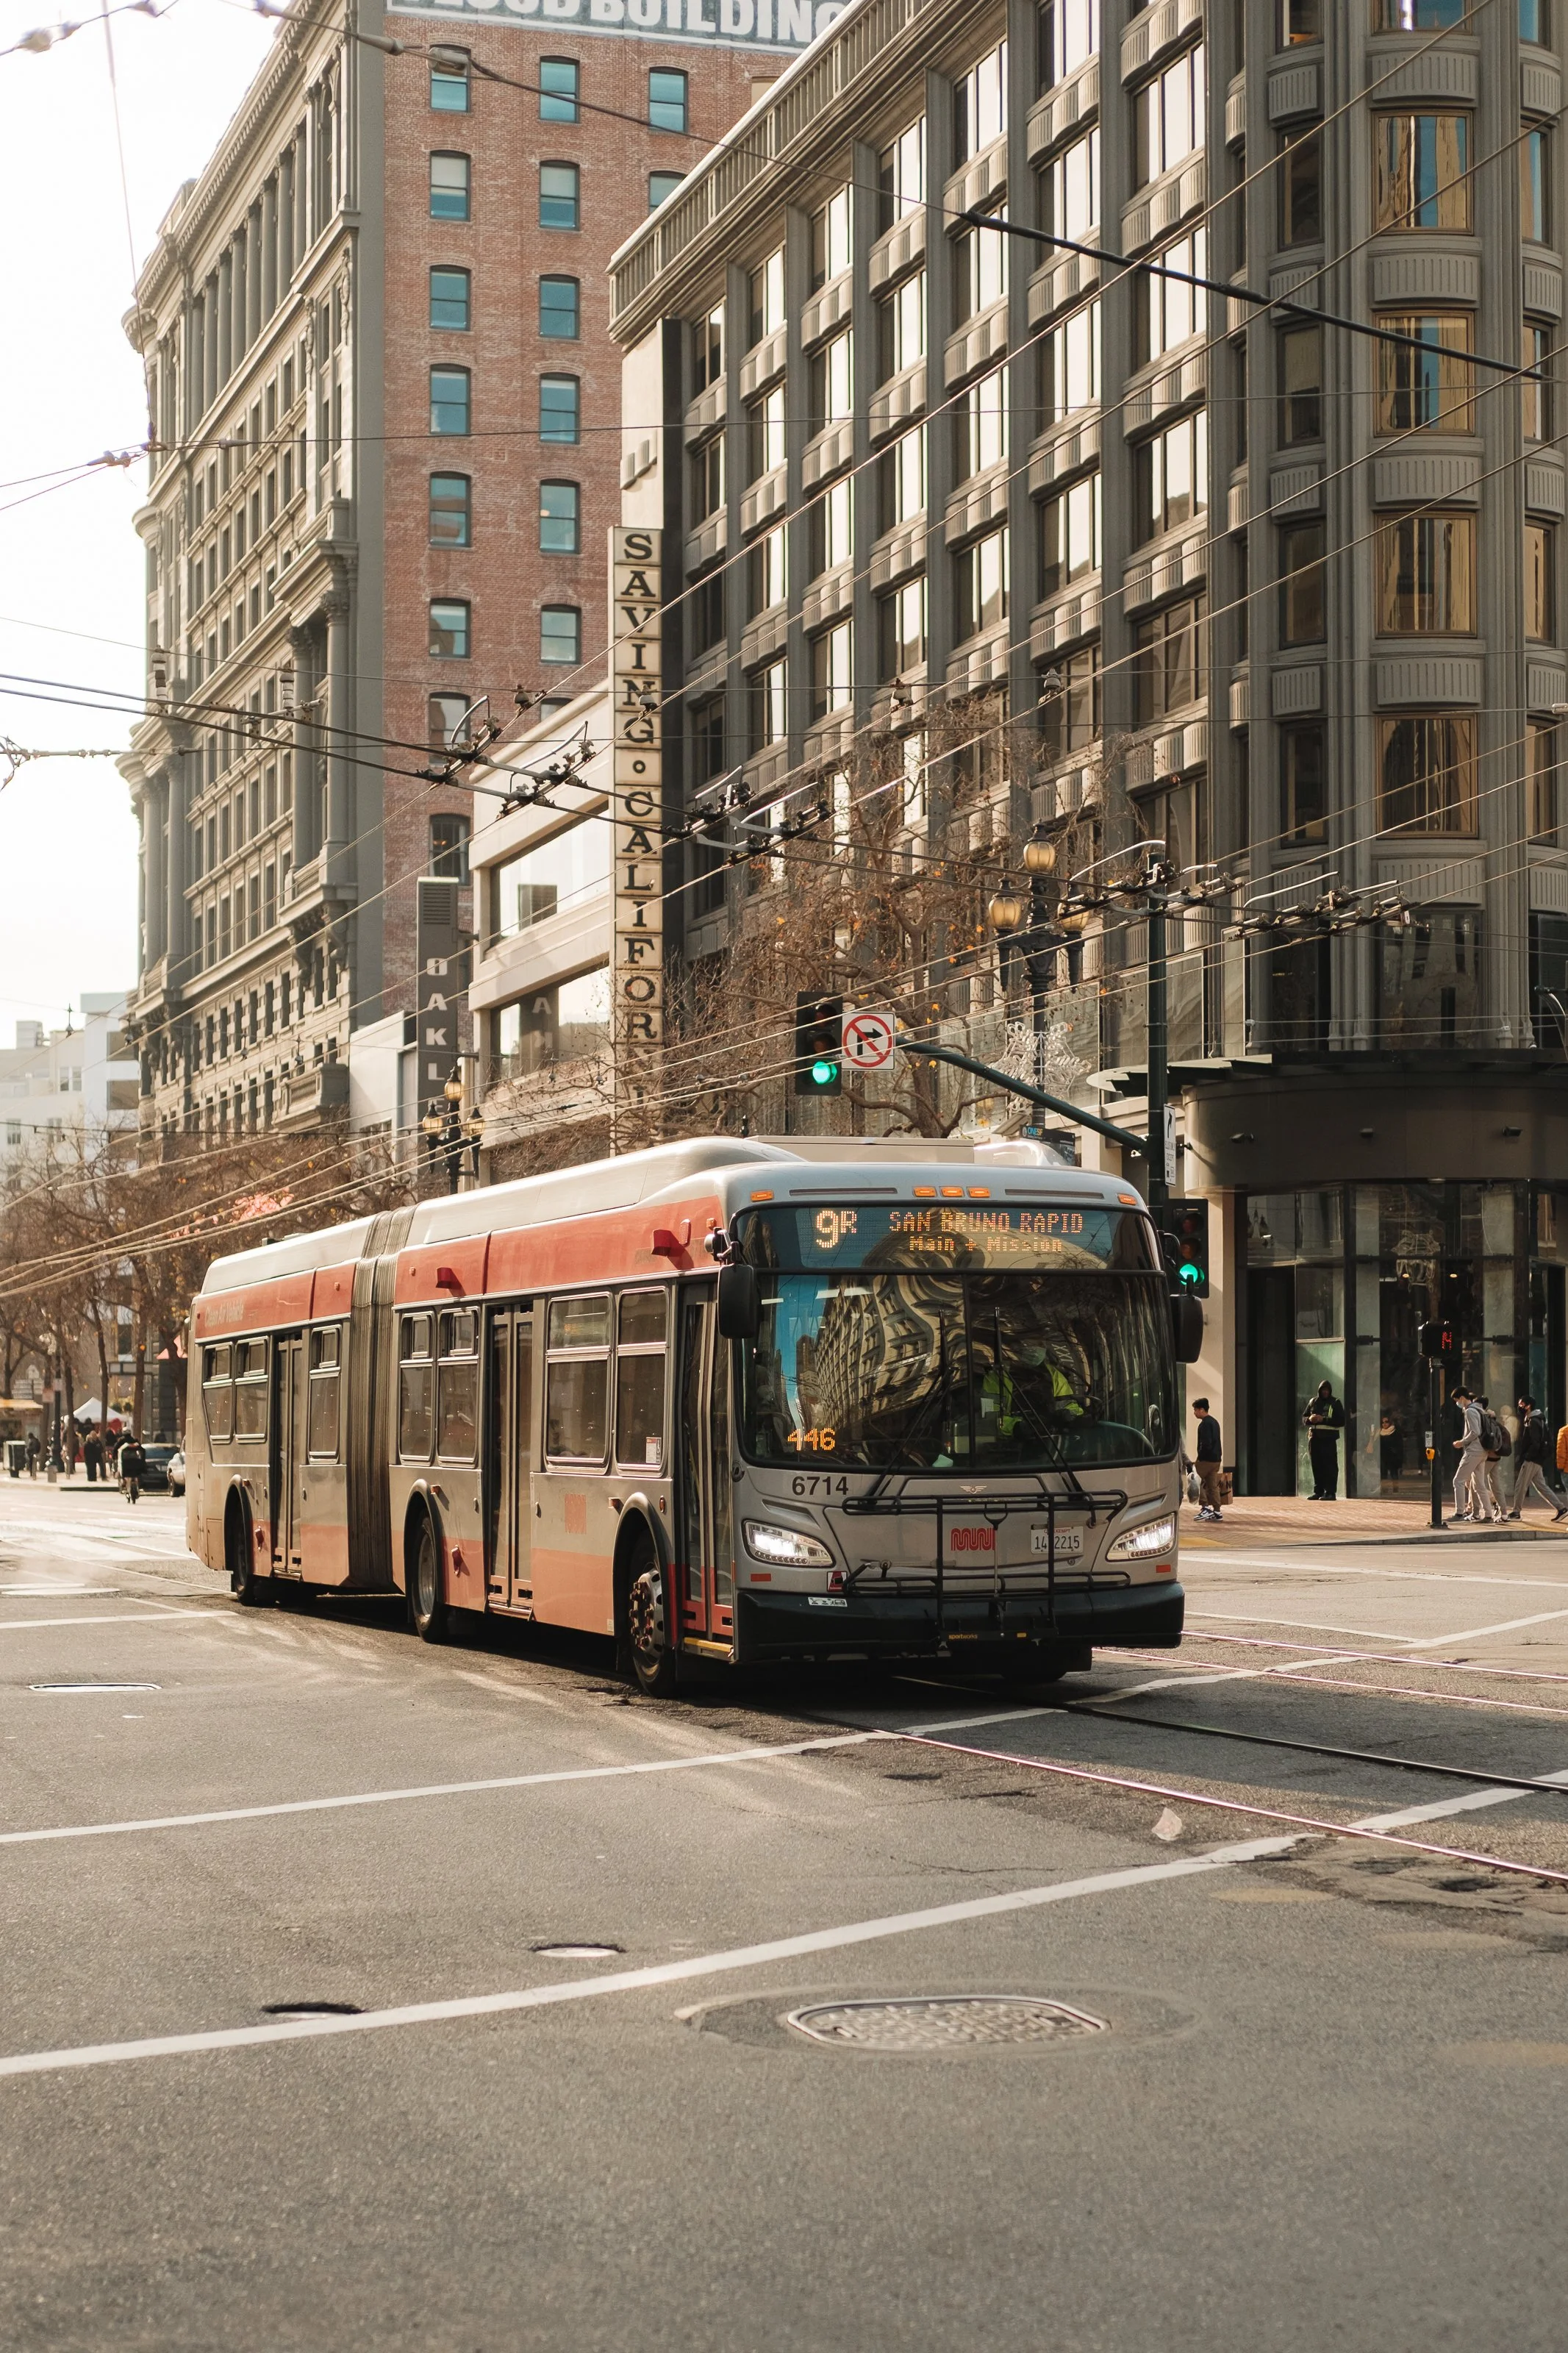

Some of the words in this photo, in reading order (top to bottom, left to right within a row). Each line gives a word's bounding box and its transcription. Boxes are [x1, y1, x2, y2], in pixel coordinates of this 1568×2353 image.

[816, 1210, 857, 1249] 9R
[889, 1210, 931, 1232] SAN
[941, 1212, 1010, 1233] BRUNO
[1020, 1212, 1083, 1233] RAPID
[909, 1236, 954, 1251] Main
[987, 1236, 1062, 1252] Mission
[787, 1428, 835, 1451] 446
[792, 1476, 849, 1496] 6714
